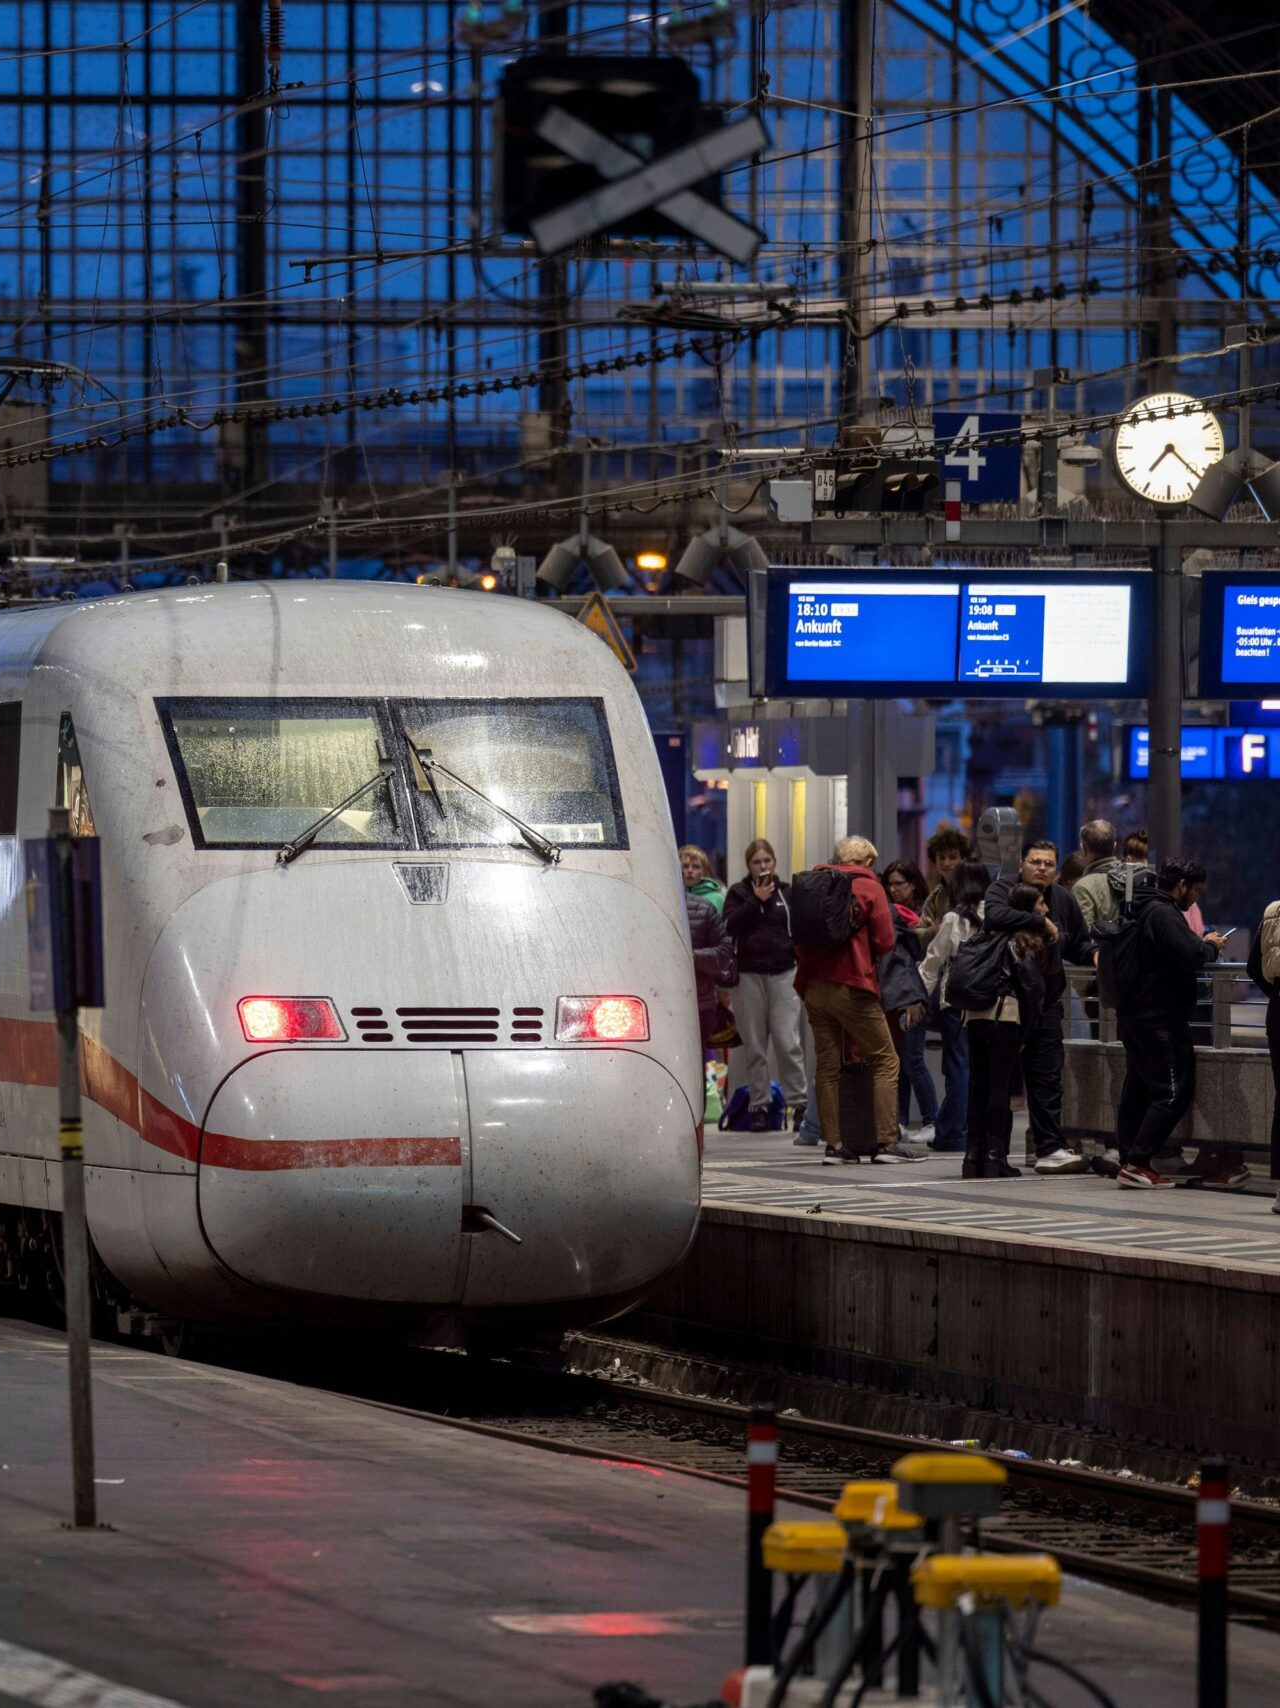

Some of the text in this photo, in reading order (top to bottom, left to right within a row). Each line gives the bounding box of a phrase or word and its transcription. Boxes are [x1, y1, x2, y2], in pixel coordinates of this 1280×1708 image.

[944, 415, 987, 481] 4
[817, 474, 834, 487] 046
[1237, 594, 1280, 607] Gleis gesp
[797, 603, 829, 616] 18:10
[968, 604, 993, 616] 19:08
[795, 618, 842, 634] Ankunft
[967, 620, 999, 631] Ankunft
[1236, 626, 1276, 636] Bauarbeiten
[1241, 733, 1266, 773] F
